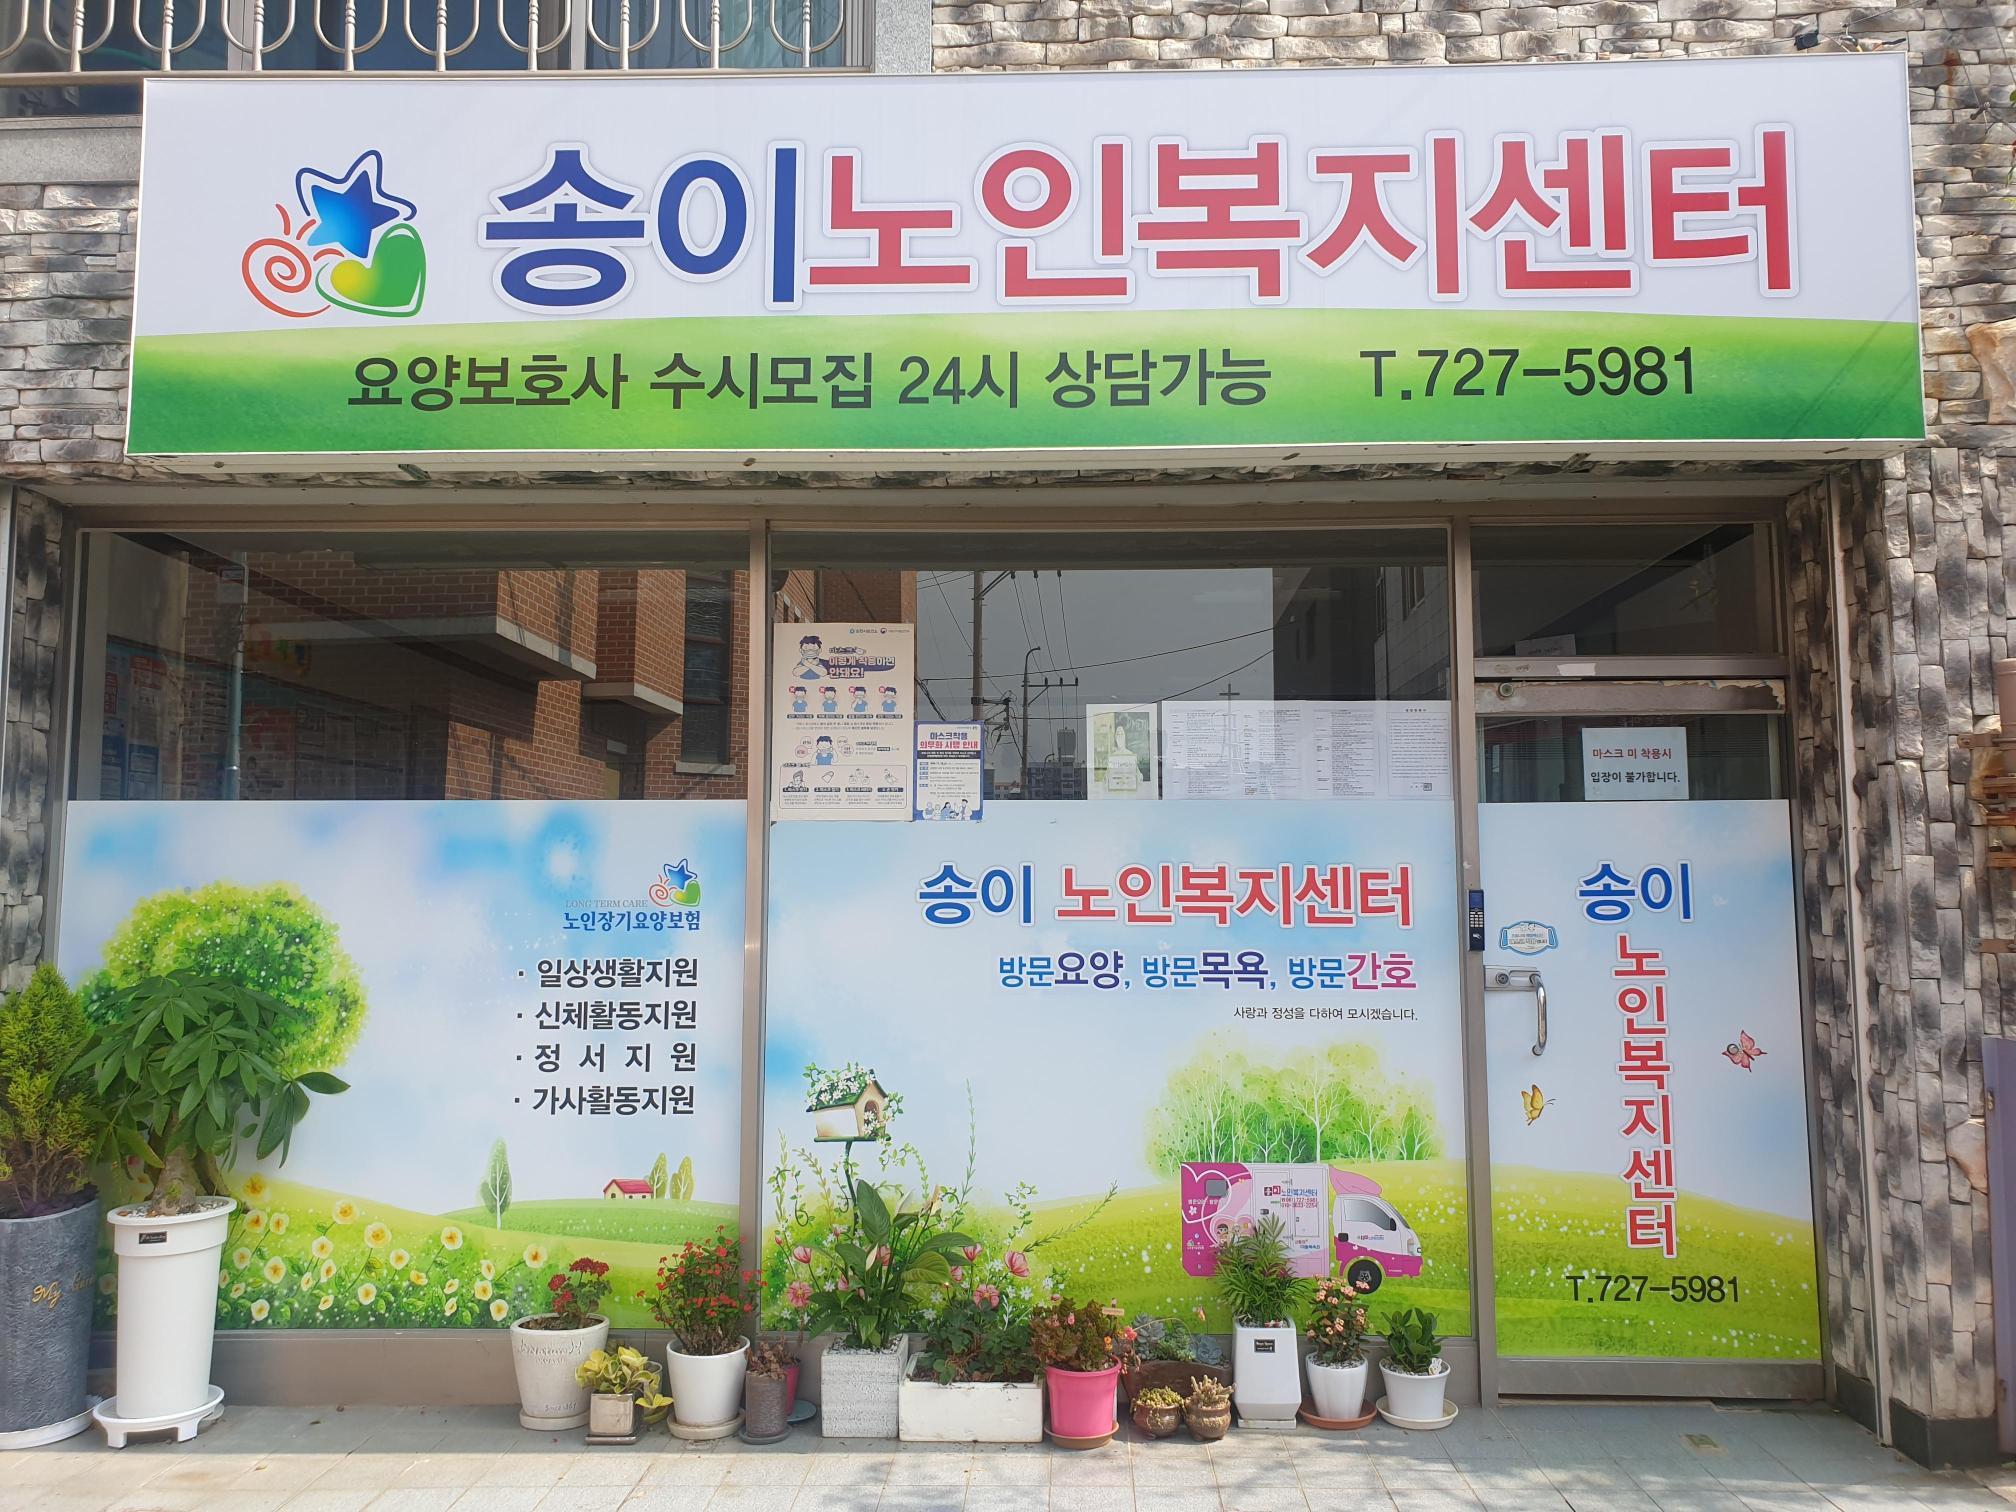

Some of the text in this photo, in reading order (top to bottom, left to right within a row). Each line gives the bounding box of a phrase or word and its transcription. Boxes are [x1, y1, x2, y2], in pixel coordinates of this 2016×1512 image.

[485, 131, 1796, 303] 송이노인복지센터
[347, 345, 1698, 411] 요양보호사 수시모집 24시 상담가능 T.727-5981
[829, 668, 865, 679] 안돼요!
[963, 741, 979, 749] 안내
[1592, 747, 1672, 759] 마스크 미 착용시
[1590, 771, 1681, 783] 입장이 불가합니다.
[566, 900, 648, 908] LONG TERM CARE
[919, 864, 1412, 926] 송이 노인복지센터
[1579, 862, 1693, 923] 송이
[562, 911, 701, 931] 노인장기요양보험
[536, 957, 699, 990] 일상생활지원
[998, 951, 1416, 990] 방문요양, 방문목욕, 방문간호
[534, 1000, 698, 1031] 신체활동지원
[1233, 1006, 1418, 1021] 사랑과 정성을 다하여 모시겠습니다.
[532, 1085, 696, 1117] 가사활동지원
[1612, 934, 1677, 1257] 노인복지센터
[1566, 1274, 1741, 1305] T.727-5981
